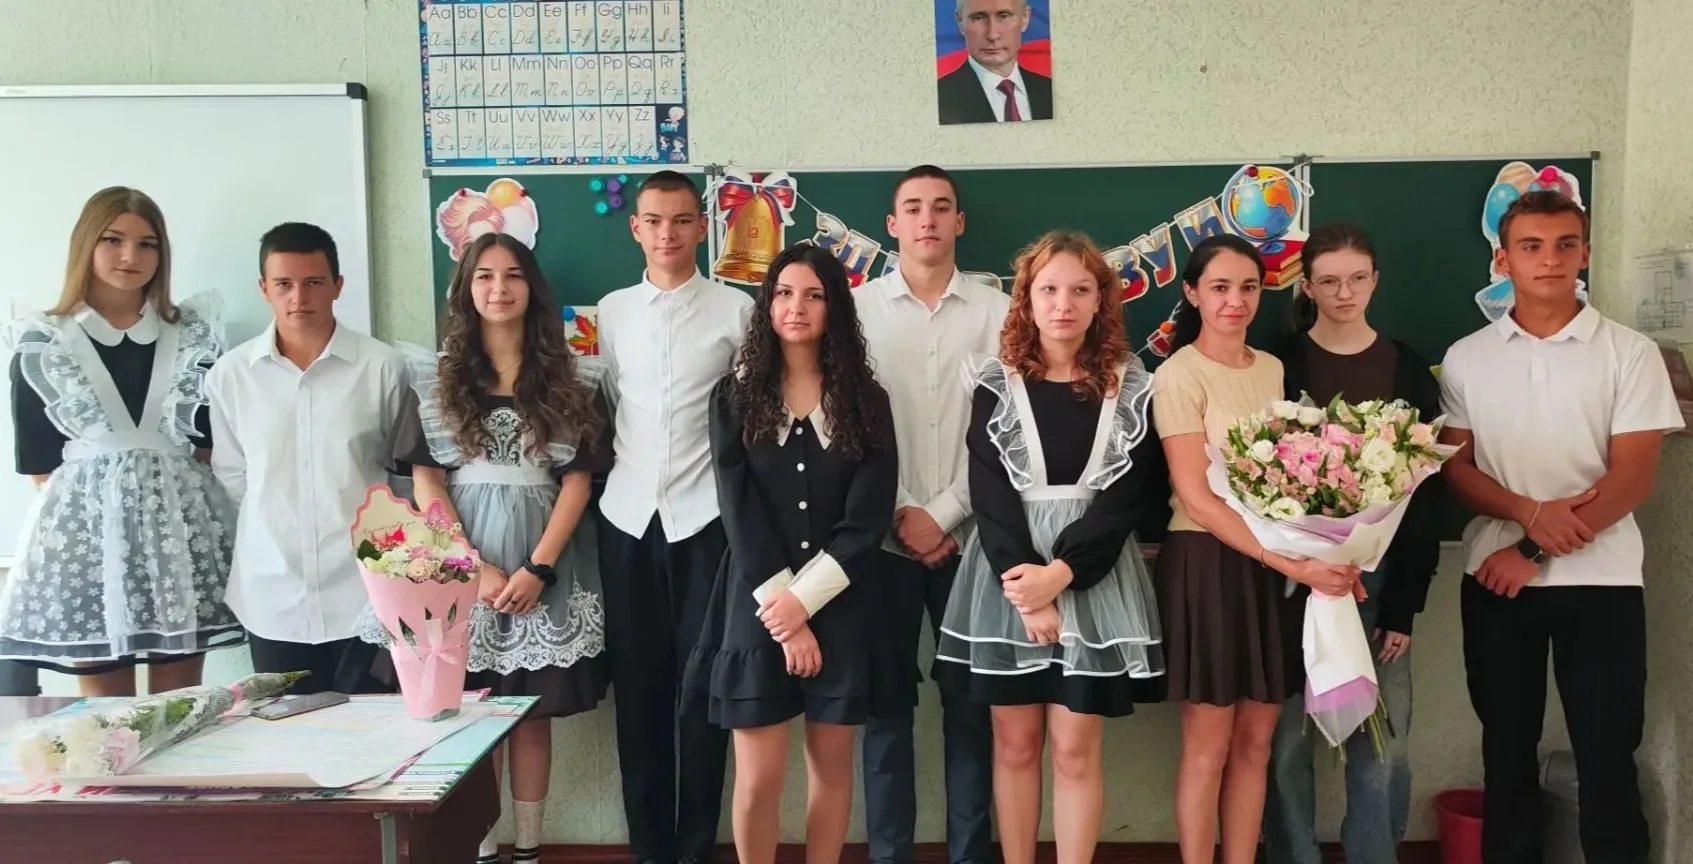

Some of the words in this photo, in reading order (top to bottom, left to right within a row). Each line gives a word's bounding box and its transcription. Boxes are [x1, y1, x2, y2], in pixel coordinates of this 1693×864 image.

[430, 6, 450, 19] Aa
[458, 6, 477, 18] Bb
[485, 5, 507, 18] Cc
[514, 5, 535, 17] Dd
[544, 4, 562, 17] Ee
[575, 4, 586, 16] Ff
[598, 3, 622, 19] Gg
[628, 3, 648, 15] Hh
[664, 3, 669, 15] Ii
[437, 57, 447, 74] Jj
[460, 58, 477, 71] Kk
[491, 58, 501, 71] Ll
[513, 57, 541, 70] Mm
[548, 57, 568, 70] Nn
[575, 57, 595, 69] Oo
[604, 56, 622, 71] Pp
[629, 56, 652, 71] Qq
[661, 55, 674, 68] Rr
[437, 111, 450, 124] Ss
[466, 111, 476, 123] Tt
[489, 111, 508, 123] Uu
[516, 111, 536, 122] Vv
[542, 109, 570, 122] Ww
[580, 110, 596, 121] Xx
[606, 109, 623, 124] Yy
[635, 109, 650, 121] Zz
